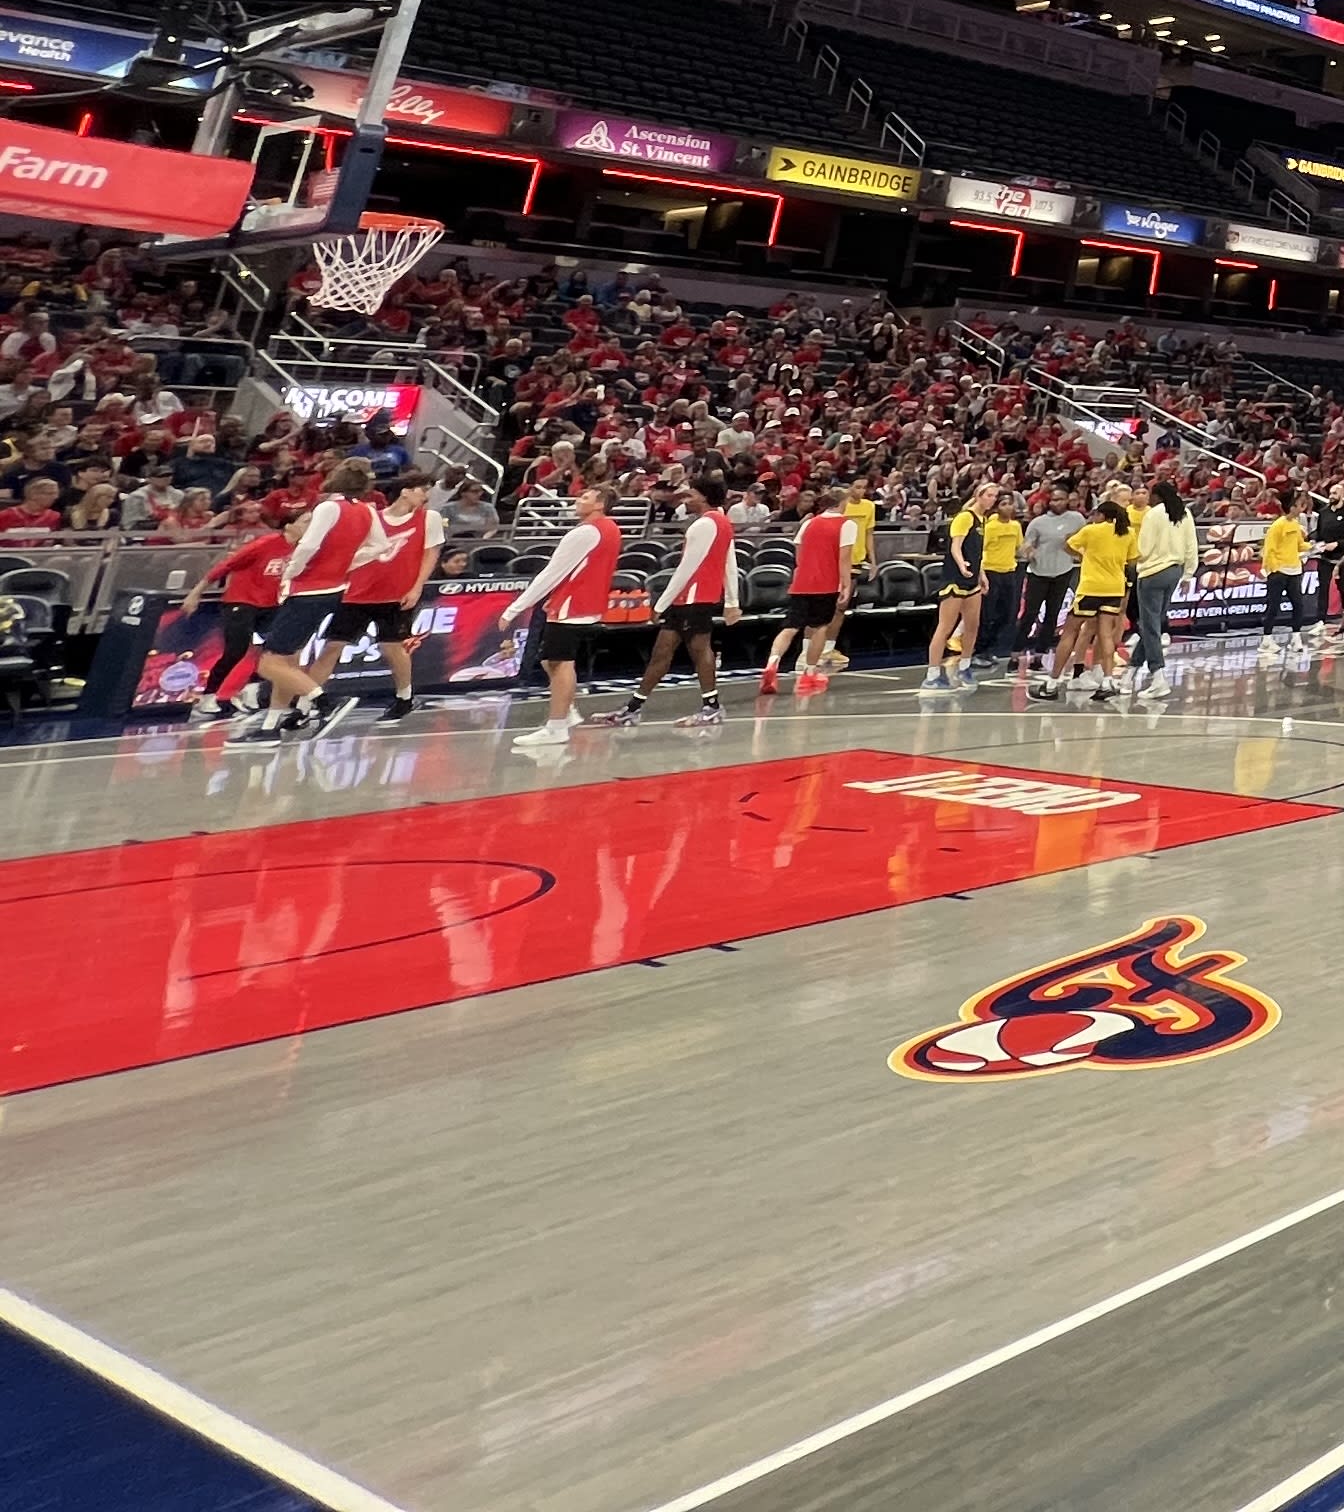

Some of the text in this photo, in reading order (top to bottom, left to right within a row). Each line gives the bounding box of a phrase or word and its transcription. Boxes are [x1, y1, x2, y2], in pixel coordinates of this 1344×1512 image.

[18, 44, 72, 63] Health
[623, 124, 712, 152] Ascension
[0, 144, 109, 190] Farm
[619, 141, 712, 169] St. Vincent
[802, 159, 915, 194] GAINBRIDGE
[1140, 212, 1180, 238] Kroger
[465, 580, 529, 593] HYUNDAI
